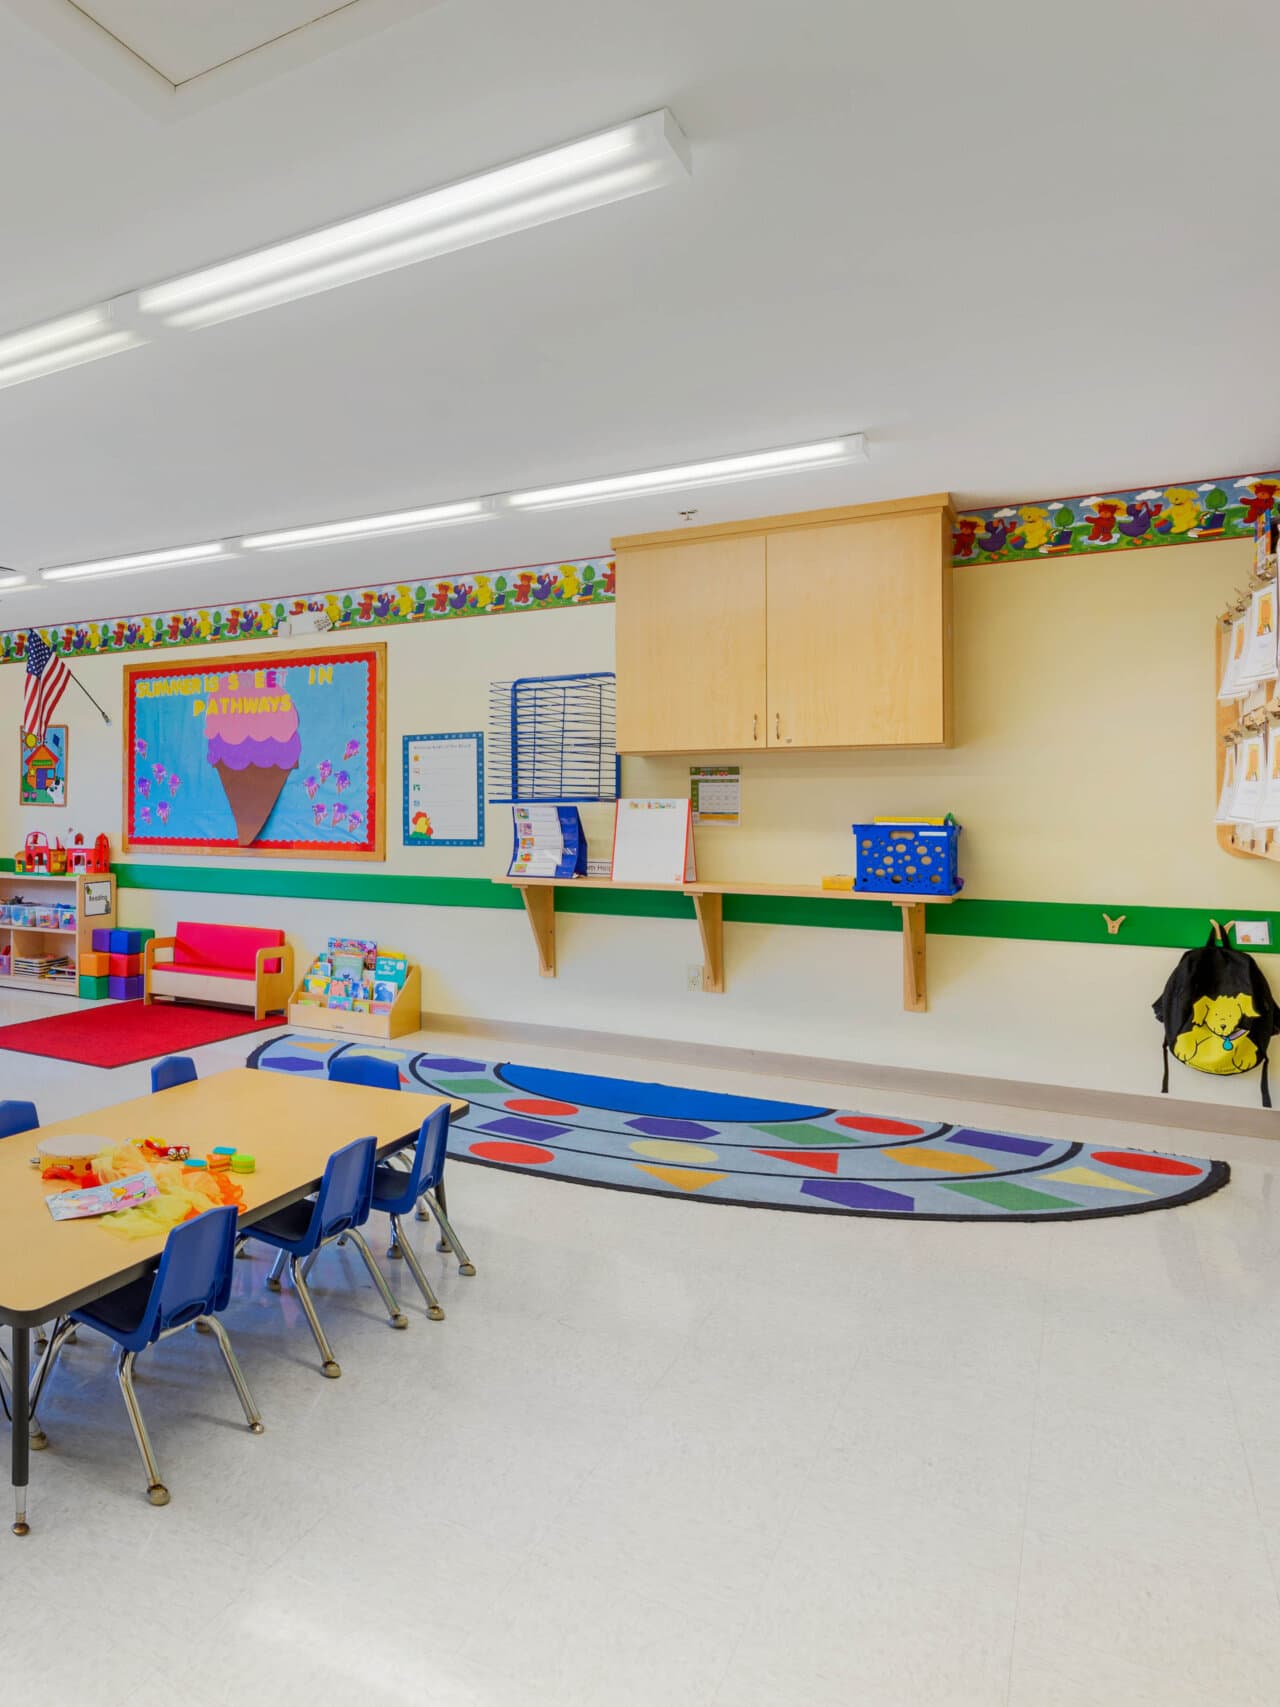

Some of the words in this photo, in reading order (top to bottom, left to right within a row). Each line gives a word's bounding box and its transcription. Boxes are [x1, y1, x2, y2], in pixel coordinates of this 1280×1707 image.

[136, 678, 201, 698] SUMMER
[205, 676, 219, 692] IS
[228, 671, 288, 690] SEET
[308, 667, 333, 685] IN
[193, 694, 292, 716] PATHWAYS
